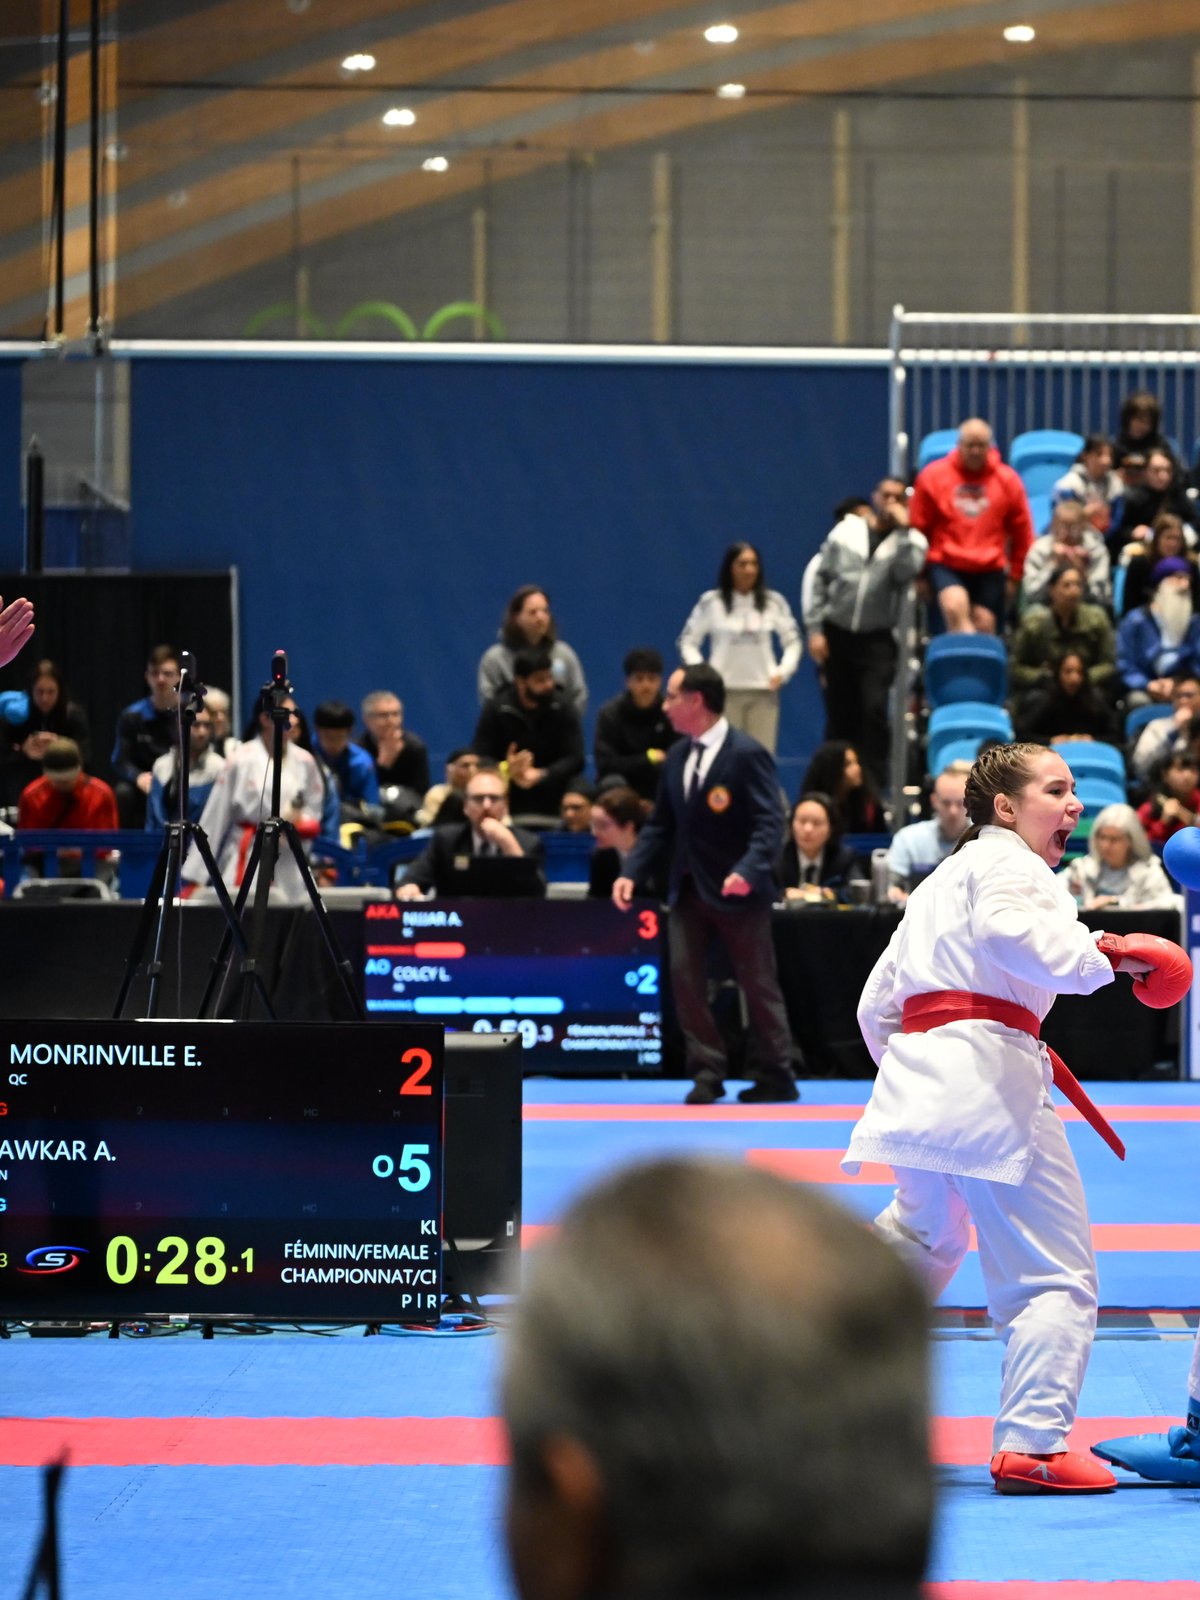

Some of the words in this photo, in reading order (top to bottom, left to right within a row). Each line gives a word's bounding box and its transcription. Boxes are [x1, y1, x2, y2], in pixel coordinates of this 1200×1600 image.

[365, 904, 399, 919] AKA
[638, 909, 659, 940] 3
[364, 958, 391, 976] AO
[9, 1044, 176, 1066] MONRINVILLE
[184, 1045, 202, 1067] E.
[8, 1073, 28, 1086] QC
[400, 1048, 432, 1095] 2
[94, 1140, 116, 1162] A.
[284, 1239, 429, 1261] FÉMININ/FEMALE
